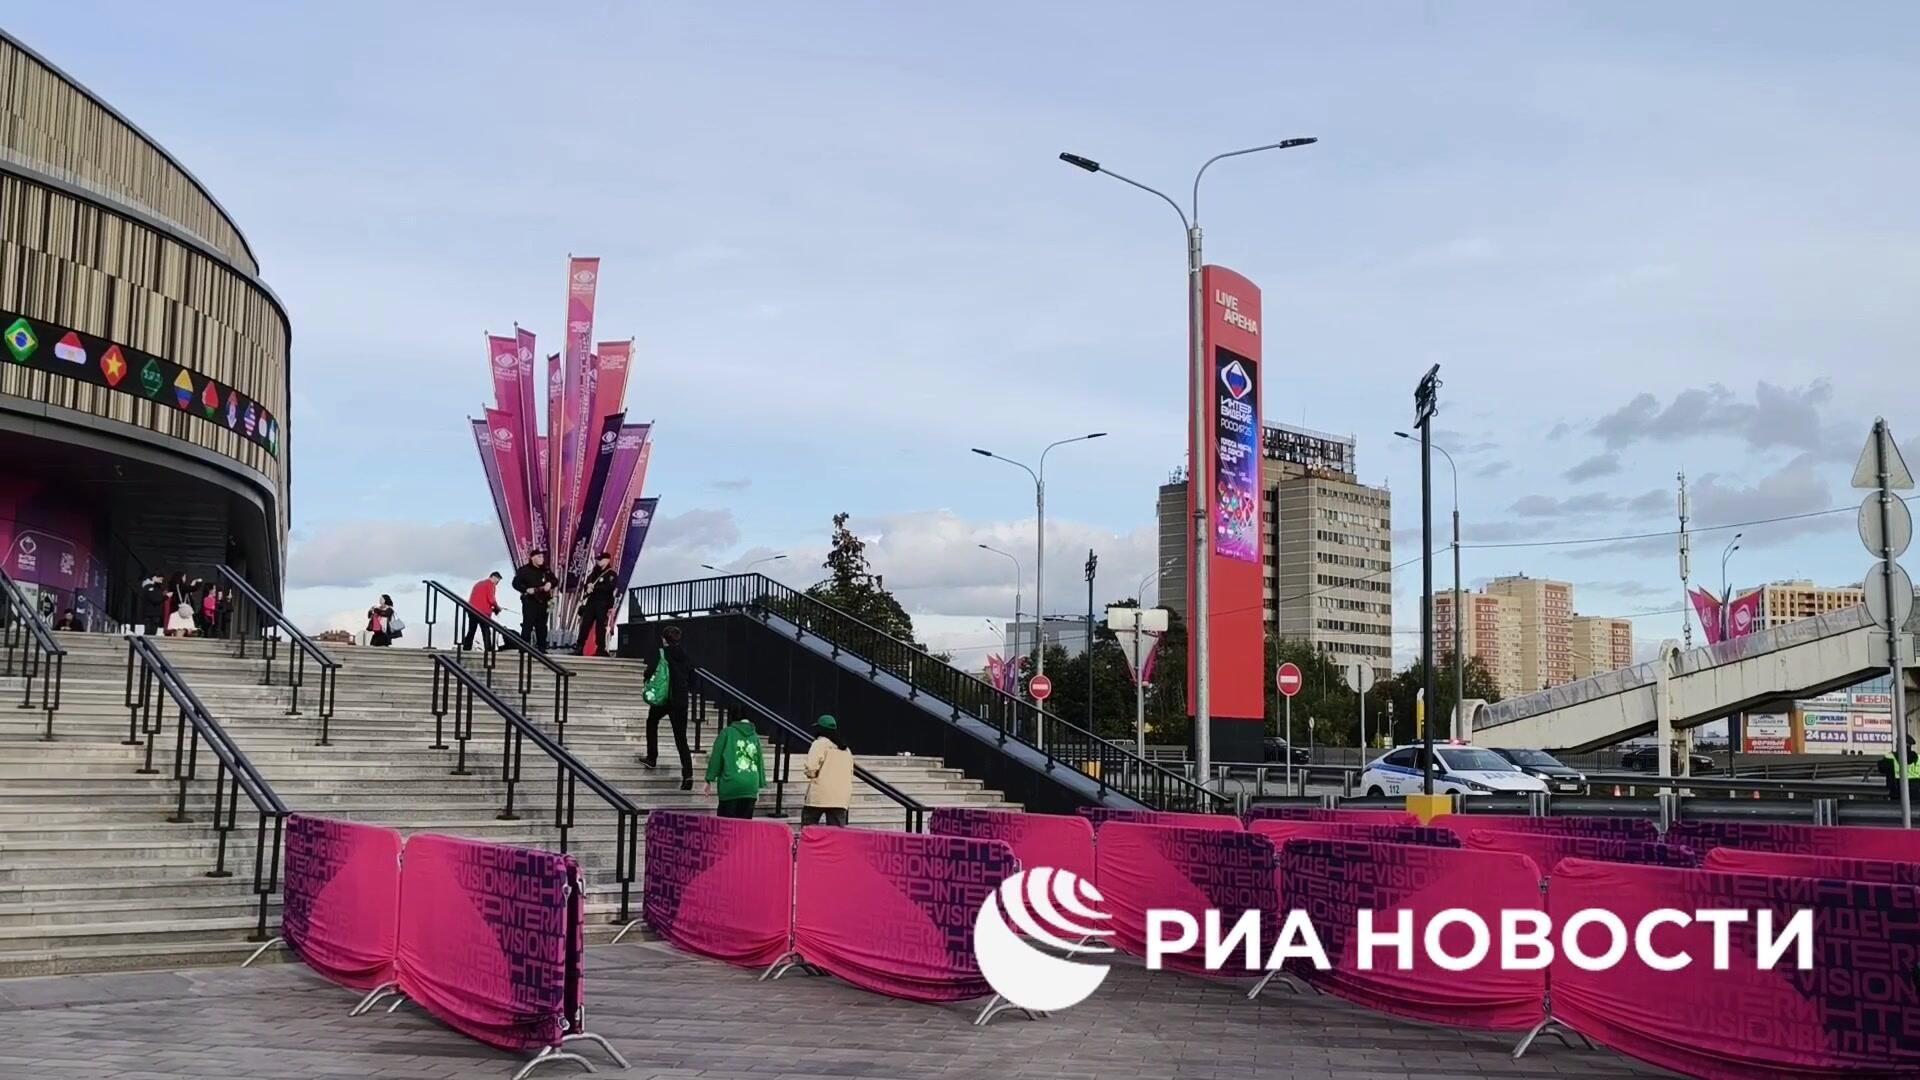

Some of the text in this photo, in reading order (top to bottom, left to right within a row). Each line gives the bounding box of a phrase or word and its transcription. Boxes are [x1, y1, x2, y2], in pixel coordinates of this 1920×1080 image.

[1215, 288, 1239, 311] LIVE
[1806, 730, 1820, 740] 24
[1820, 731, 1847, 741] БАЗА
[1389, 784, 1400, 794] 112
